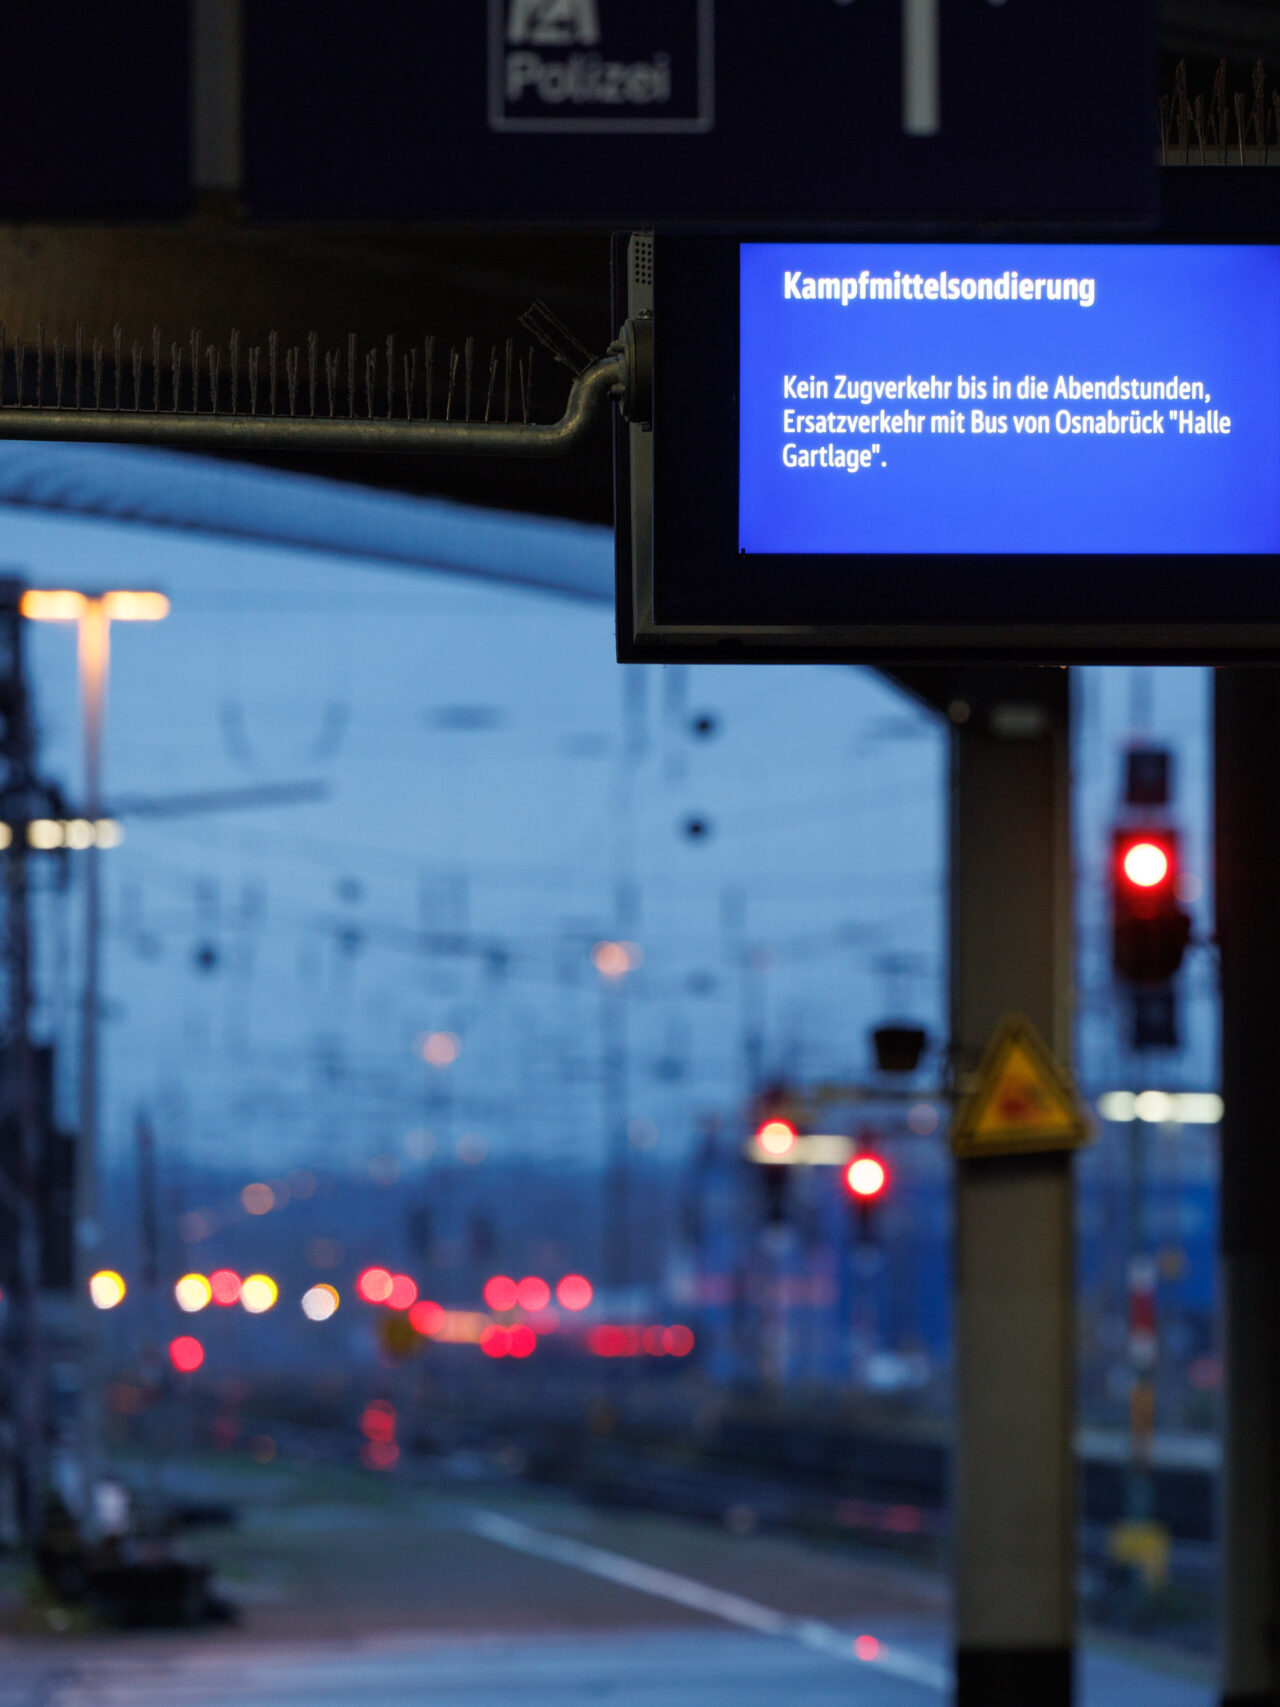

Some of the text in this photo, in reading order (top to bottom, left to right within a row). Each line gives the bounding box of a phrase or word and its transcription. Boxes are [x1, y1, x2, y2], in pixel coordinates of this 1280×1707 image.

[506, 52, 670, 103] Polizei
[784, 270, 1096, 308] Kampfmittelsondierung
[784, 375, 1212, 404] Kein Zugverkehr bis in die Abendstunden,
[784, 409, 1232, 434] Ersatzverkehr mit Bus von Osnabrück "Halle
[783, 443, 888, 473] Gartlage".
